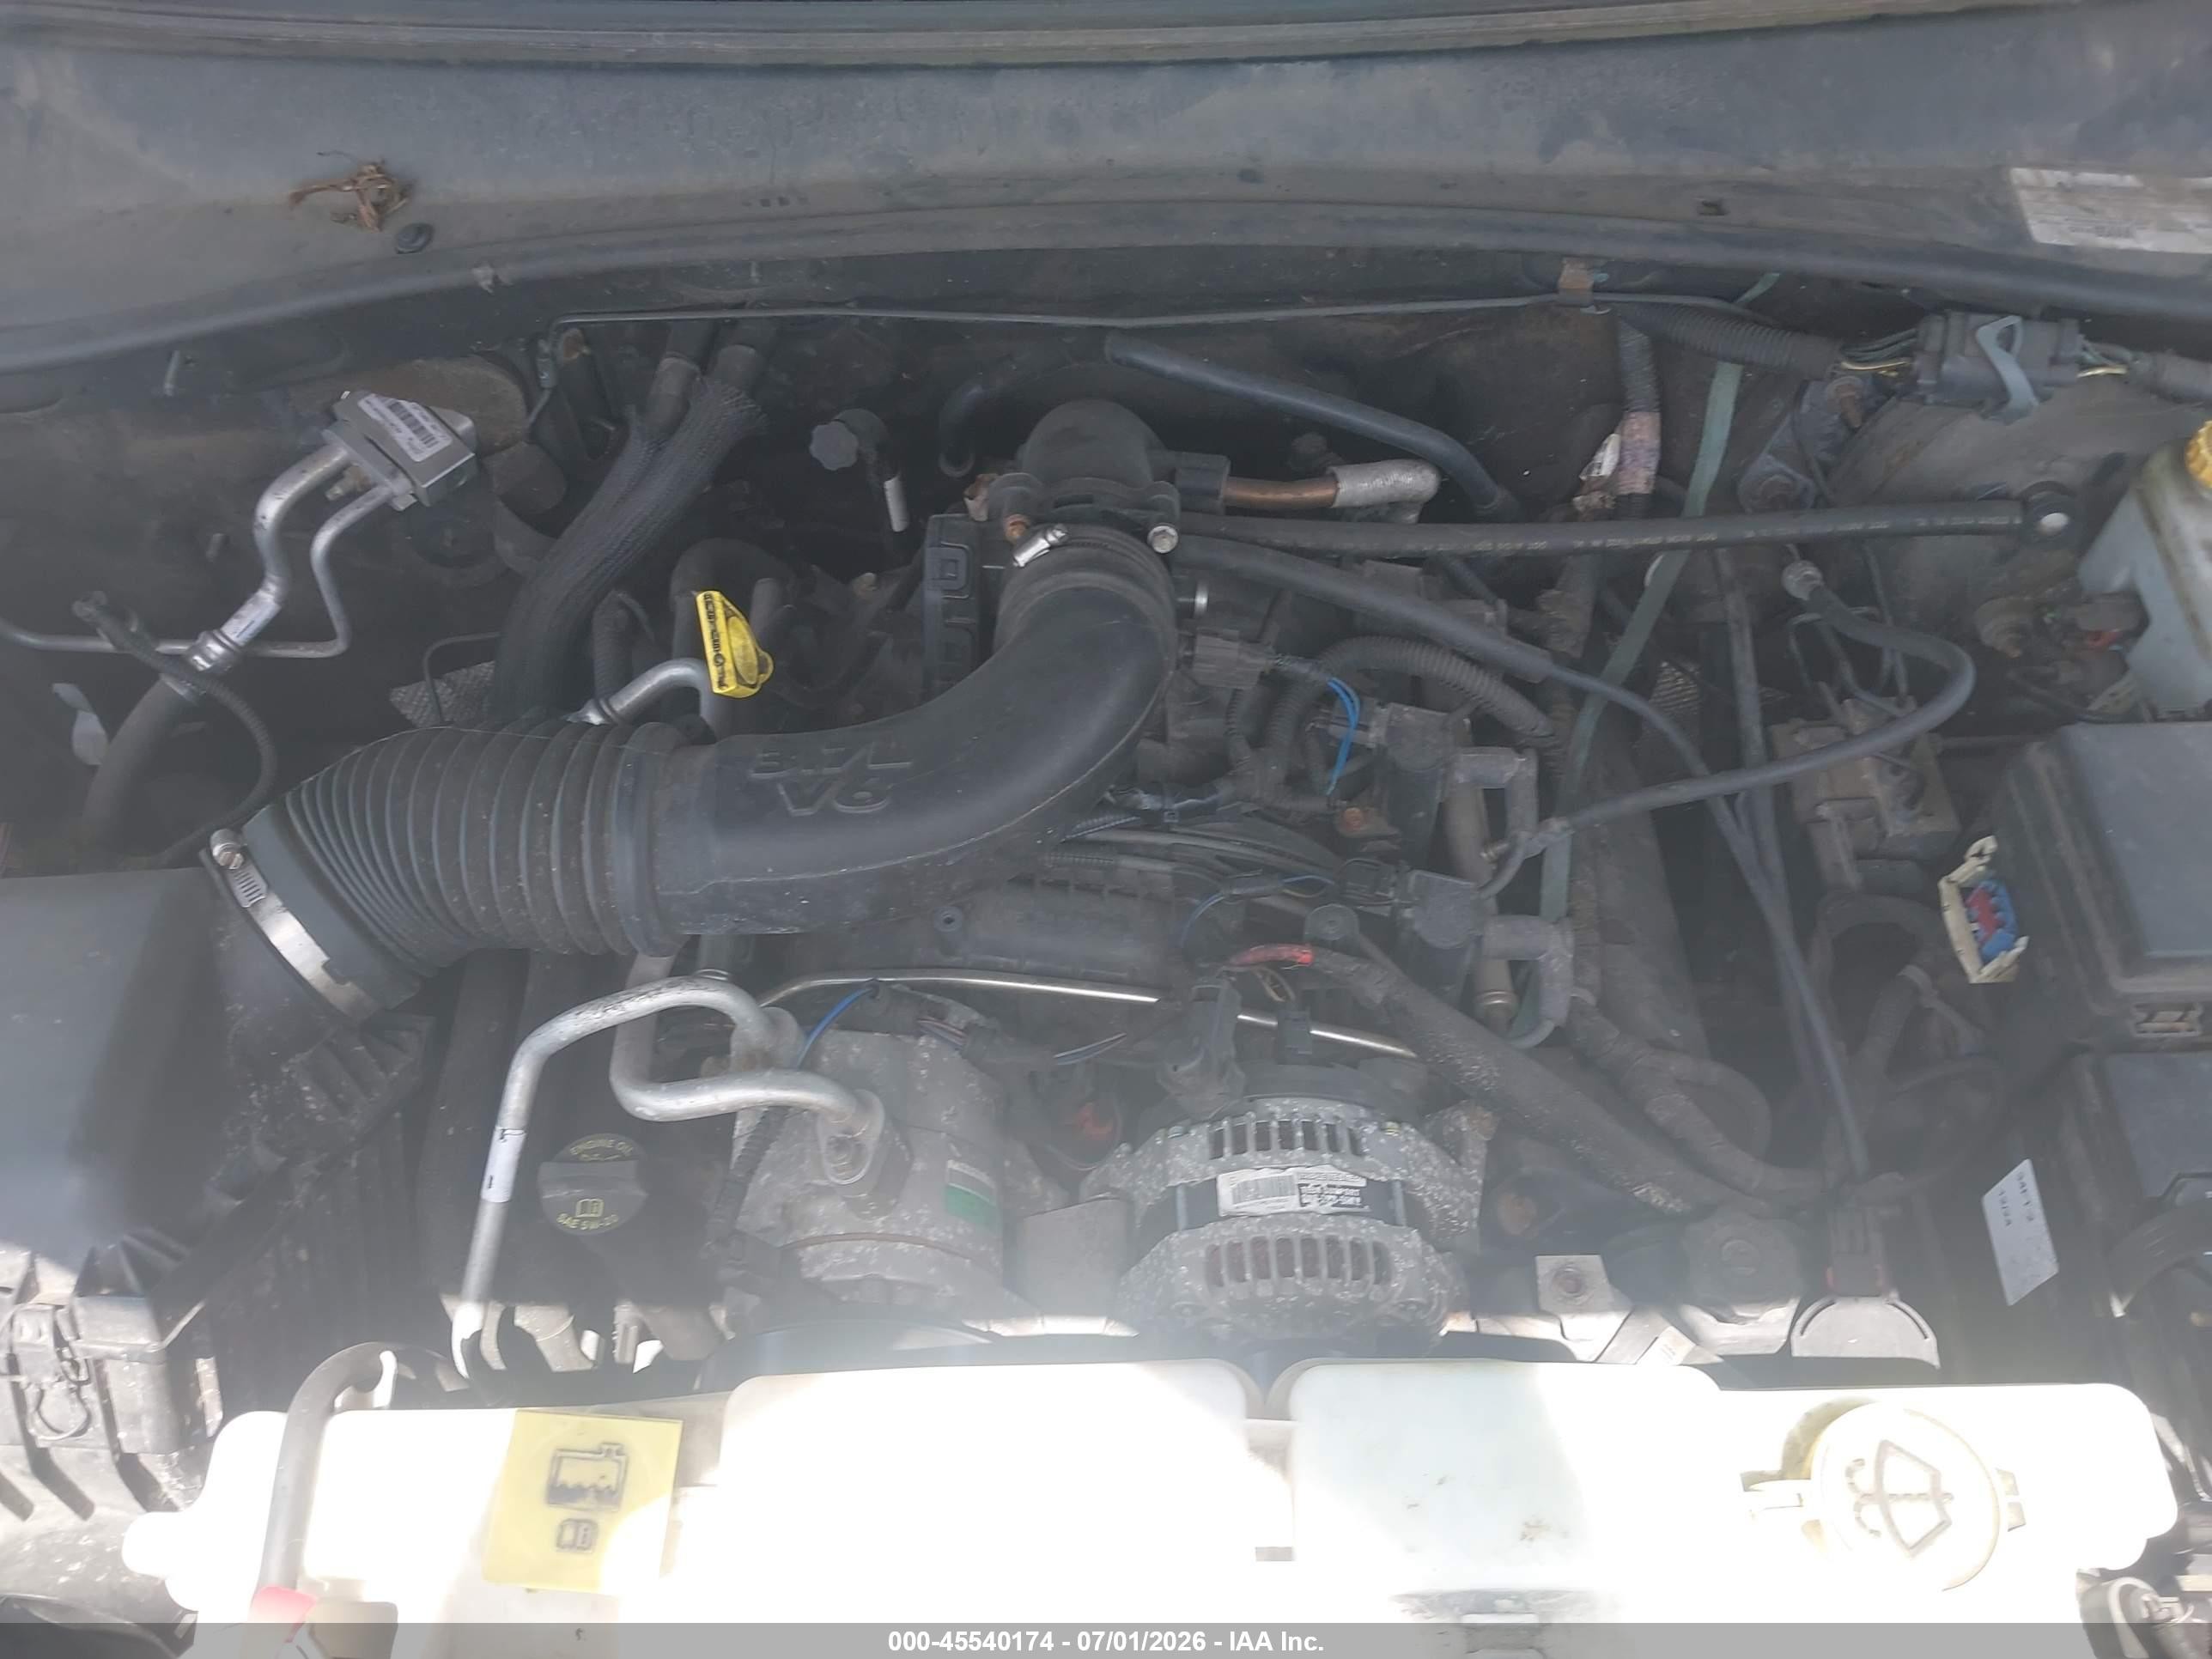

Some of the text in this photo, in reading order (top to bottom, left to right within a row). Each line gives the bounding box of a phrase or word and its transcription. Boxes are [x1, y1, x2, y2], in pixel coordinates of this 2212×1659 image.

[748, 740, 912, 778] 3.7L
[776, 776, 893, 816] V6
[569, 1139, 635, 1157] ENGINE OIL
[556, 1212, 581, 1229] SAE
